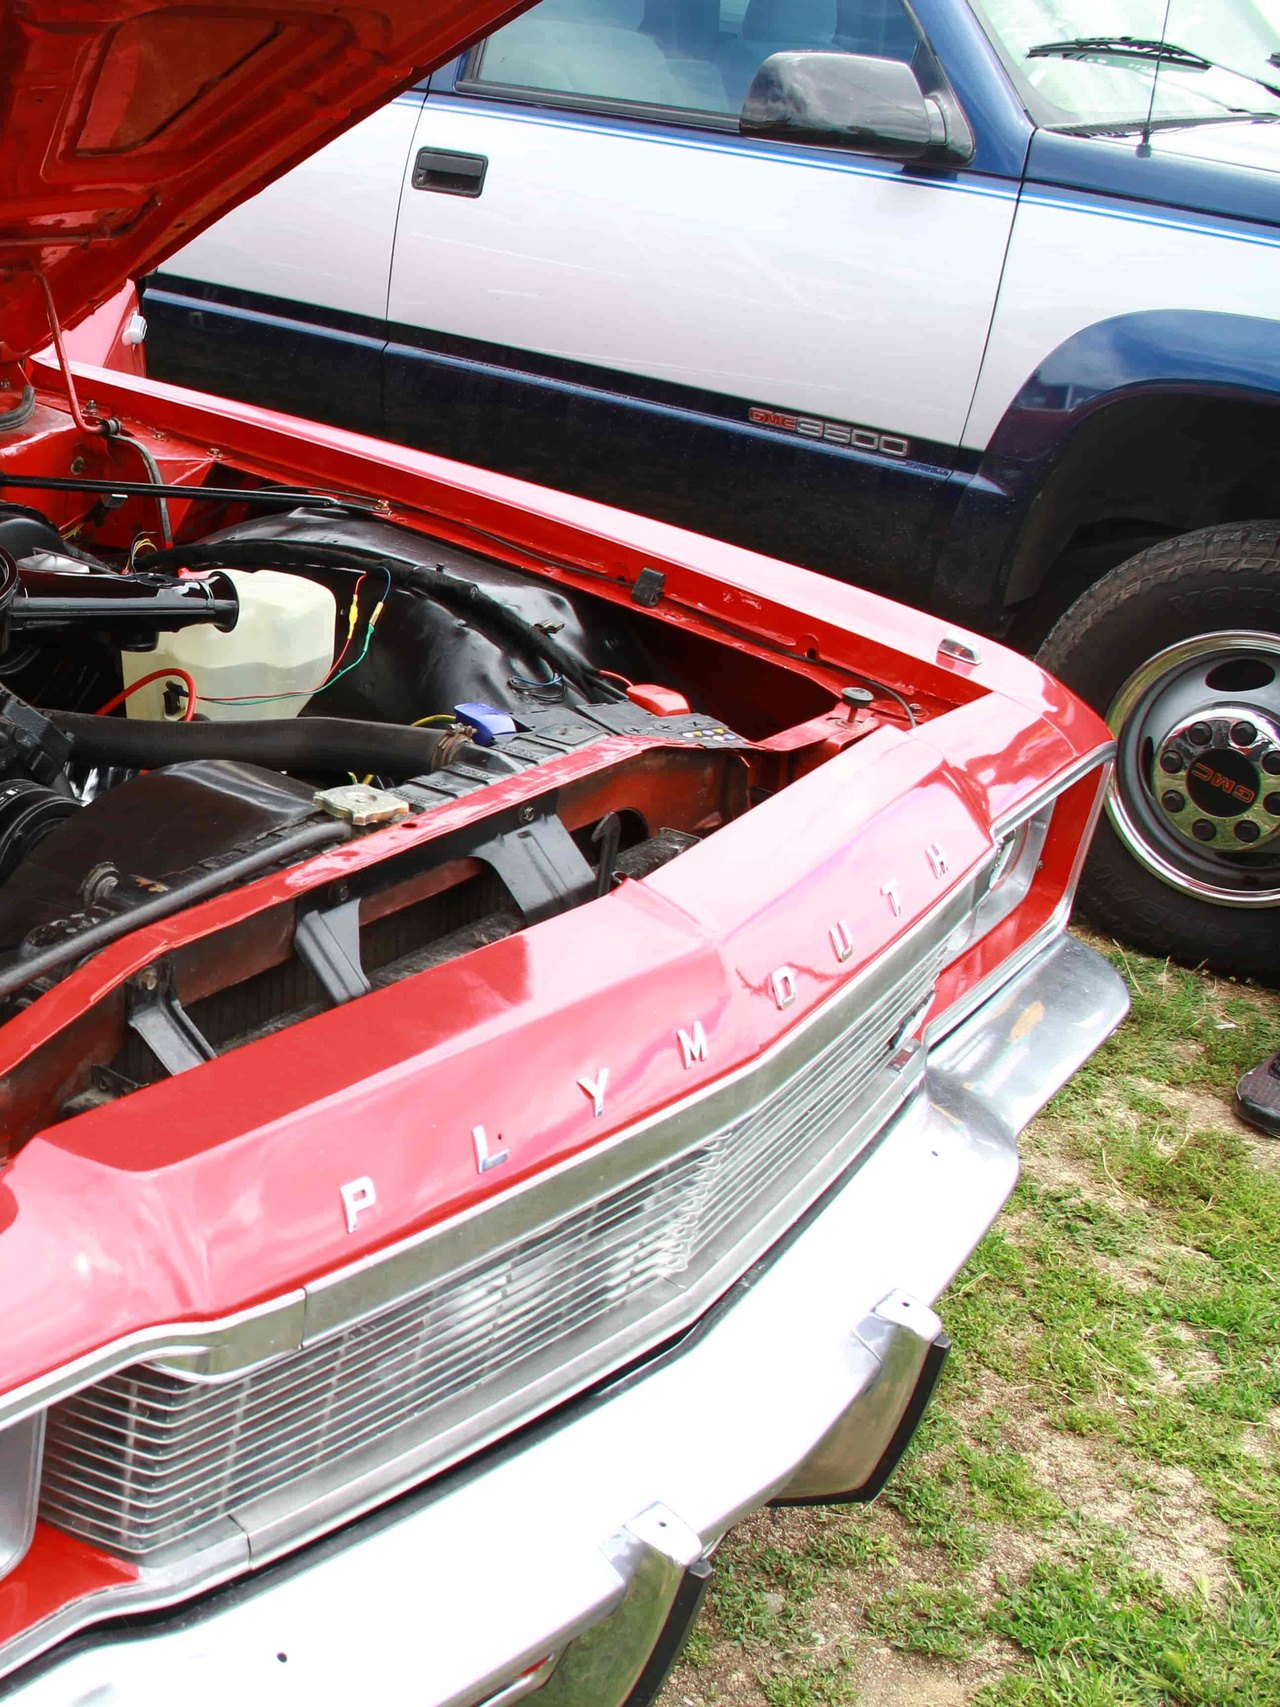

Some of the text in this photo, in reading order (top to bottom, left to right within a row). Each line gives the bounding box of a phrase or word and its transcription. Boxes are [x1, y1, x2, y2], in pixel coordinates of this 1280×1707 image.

[750, 408, 908, 458] GMC 3500
[1192, 762, 1256, 804] GMC
[340, 842, 950, 1234] PLYMOUTH
